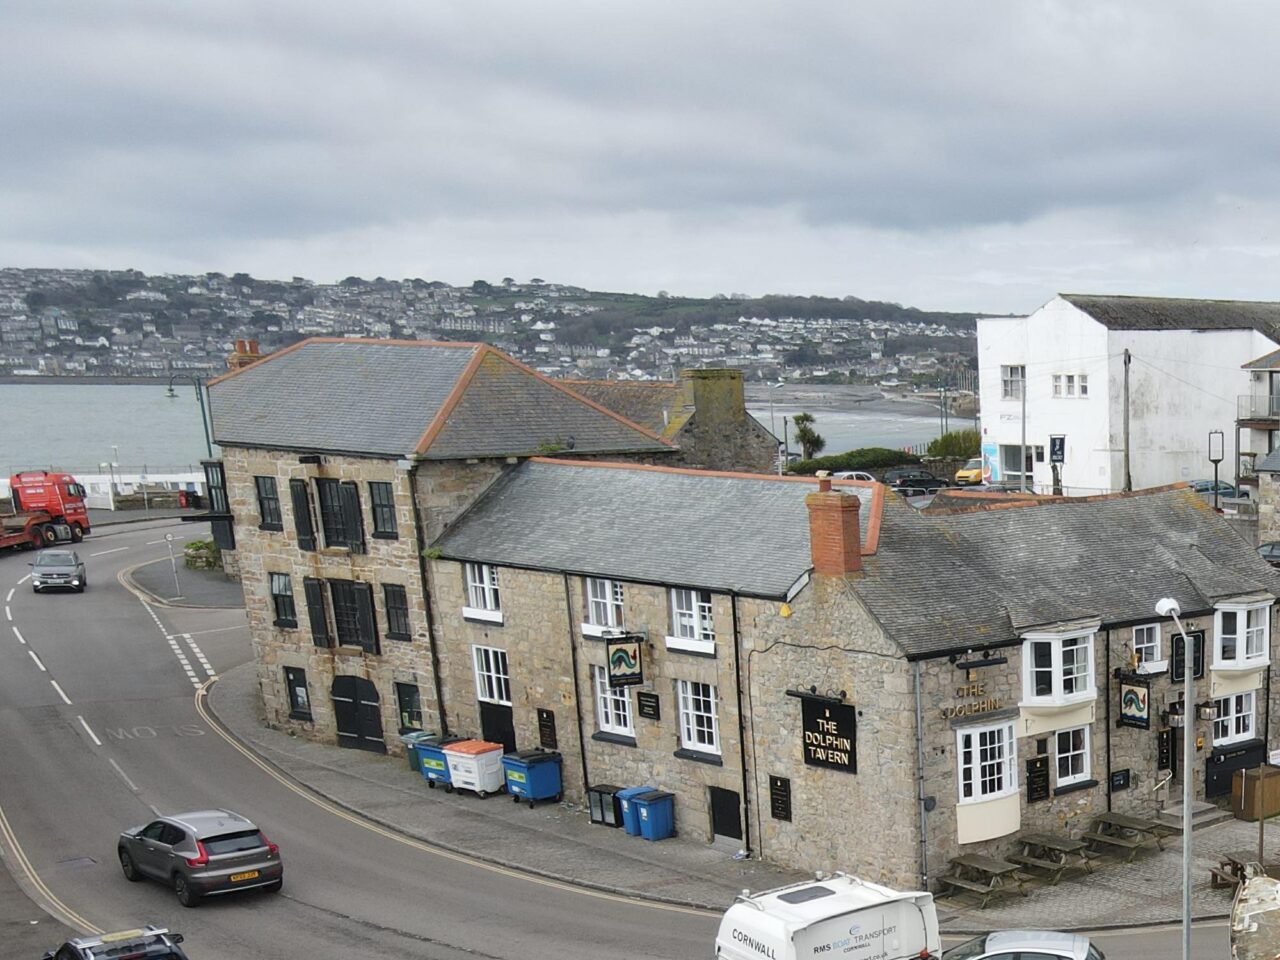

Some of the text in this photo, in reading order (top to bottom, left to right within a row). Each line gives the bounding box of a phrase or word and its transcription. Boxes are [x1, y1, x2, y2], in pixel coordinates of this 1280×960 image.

[958, 684, 985, 698] THE
[947, 699, 1000, 718] DOLPHIN
[816, 718, 838, 734] THE
[805, 731, 851, 751] DOLPHIN
[808, 746, 849, 765] TAVERN
[732, 928, 776, 960] CORNWALL
[813, 943, 831, 954] RMS
[854, 925, 897, 944] TRANSPORT
